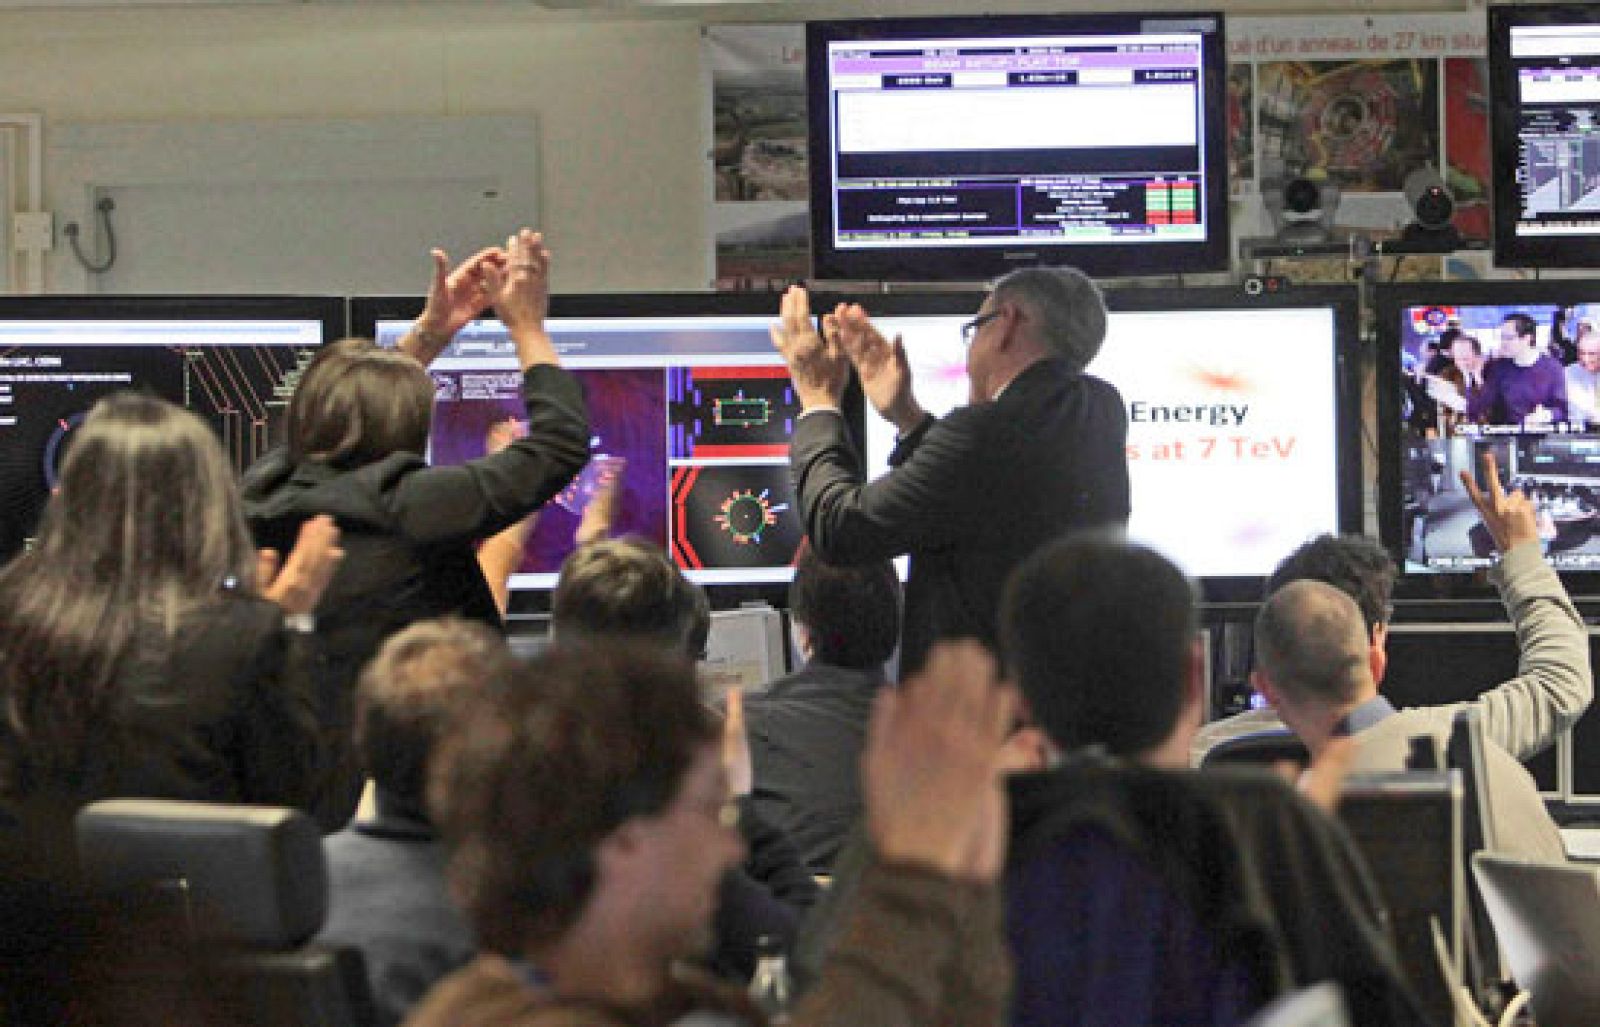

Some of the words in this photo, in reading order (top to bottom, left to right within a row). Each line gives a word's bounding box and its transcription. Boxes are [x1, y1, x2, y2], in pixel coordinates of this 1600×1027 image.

[1255, 35, 1293, 54] d'un
[1298, 37, 1361, 53] anneau
[1366, 34, 1389, 51] de
[1394, 32, 1415, 50] 27
[1419, 33, 1447, 50] km
[1130, 401, 1249, 428] Energy
[1151, 441, 1185, 461] at
[1197, 435, 1218, 460] 7
[1227, 435, 1297, 461] TeV
